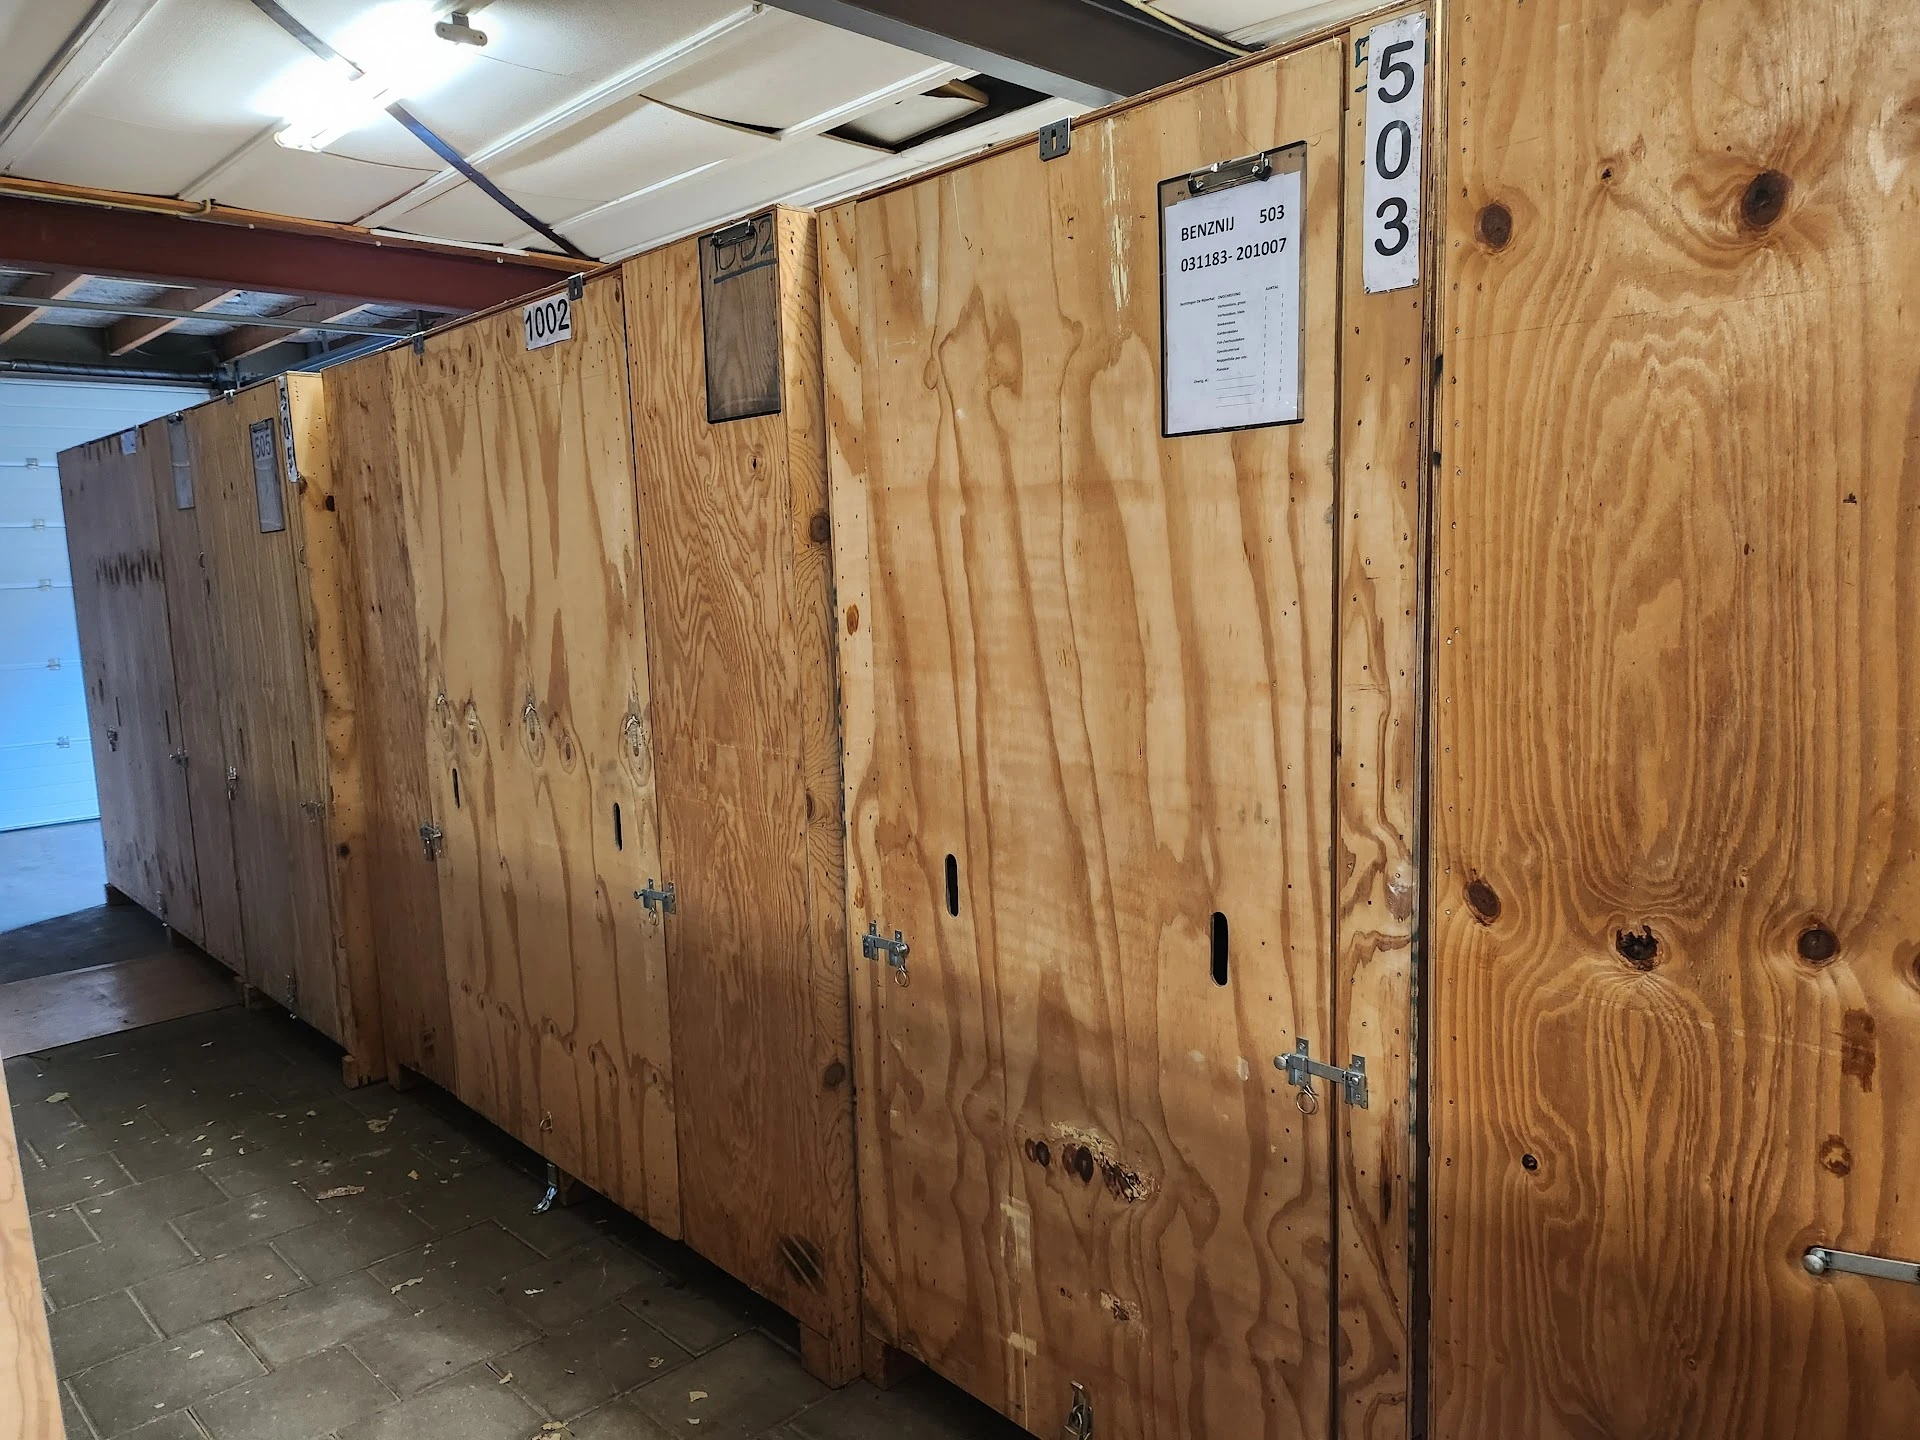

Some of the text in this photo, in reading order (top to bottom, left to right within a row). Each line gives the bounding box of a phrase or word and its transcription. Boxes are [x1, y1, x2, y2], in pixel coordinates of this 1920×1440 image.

[1374, 39, 1415, 257] 503
[1181, 204, 1285, 242] BENZNIJ 503
[1236, 237, 1287, 261] 201007
[525, 298, 569, 341] 1002
[254, 433, 272, 460] 505
